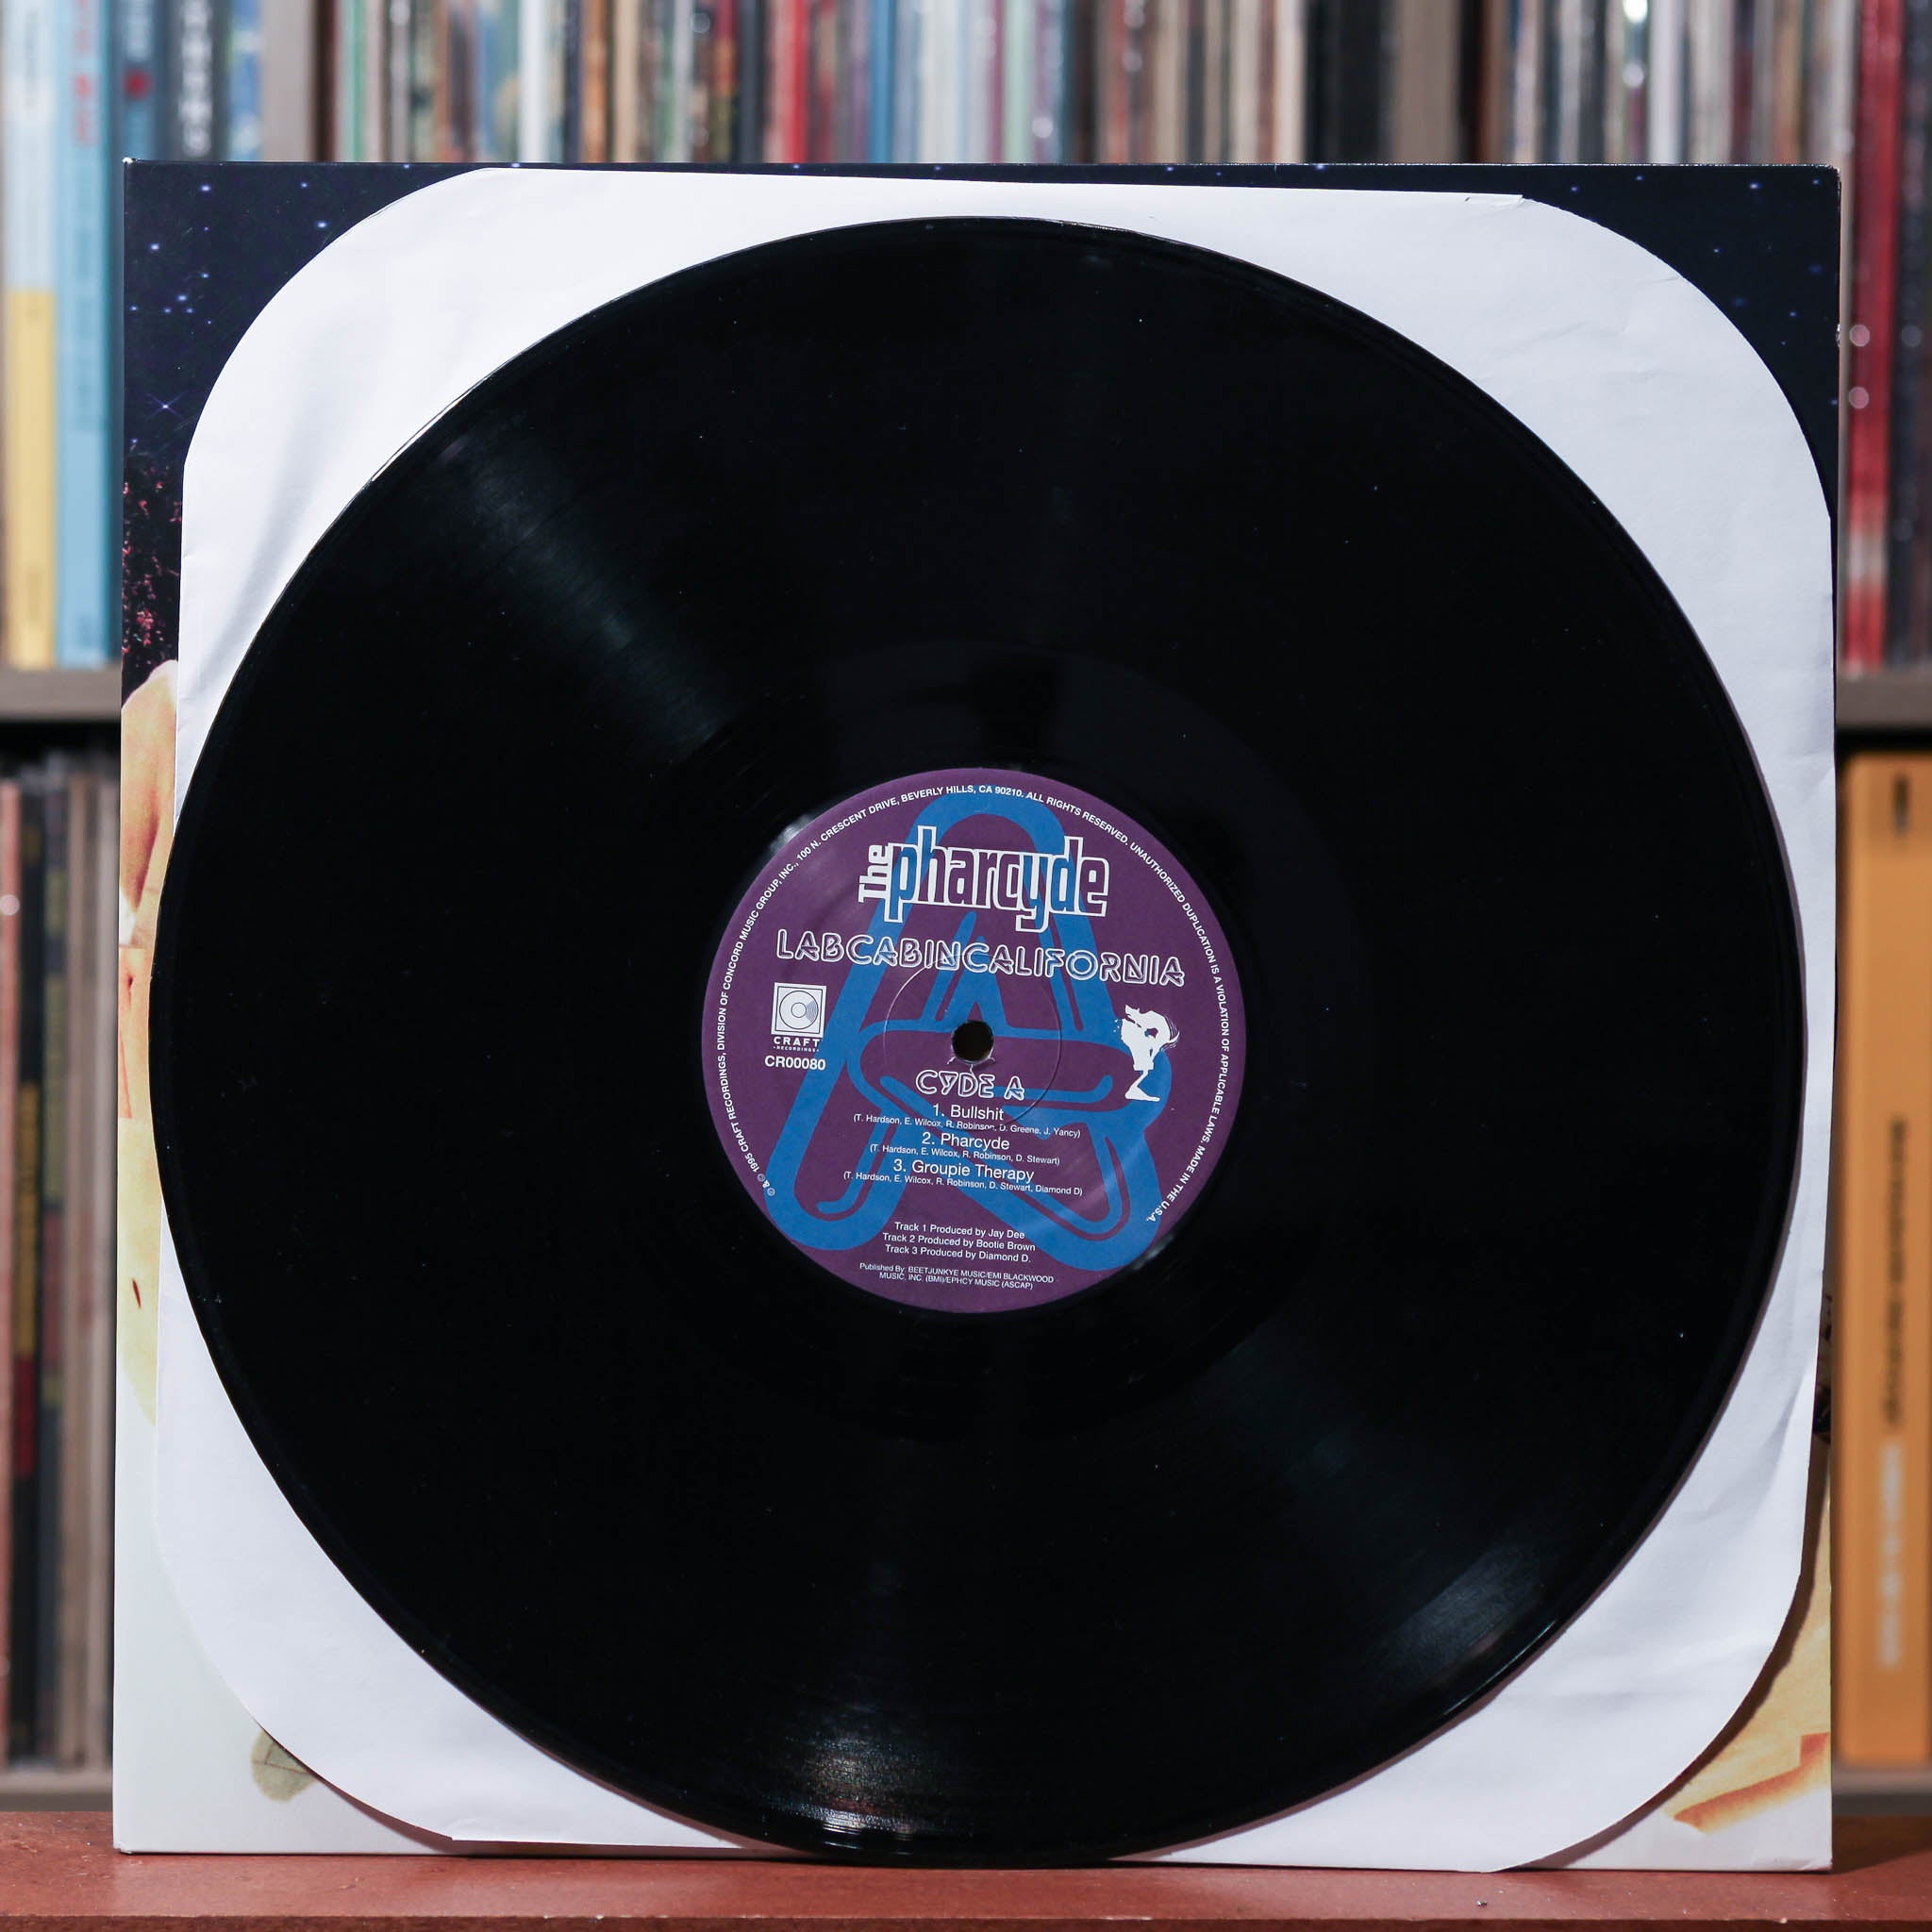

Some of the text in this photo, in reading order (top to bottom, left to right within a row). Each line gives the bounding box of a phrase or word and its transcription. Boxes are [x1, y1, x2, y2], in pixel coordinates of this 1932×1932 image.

[901, 788, 943, 803] BEVERLY
[945, 786, 976, 794] HILLS,
[994, 786, 1024, 797] 90210.
[1025, 791, 1045, 802] ALL
[867, 796, 899, 813] DRIVE,
[1045, 796, 1082, 816] RIGHTS
[820, 809, 867, 841] CRESCENT
[1081, 810, 1131, 845] RESERVED.
[795, 846, 811, 861] 100
[809, 838, 821, 849] N.
[858, 824, 1109, 933] The pharcyde
[1129, 841, 1185, 903] UNAUTHORIZED
[756, 877, 782, 910] GROUP,
[740, 909, 759, 941] MUSIC
[1181, 902, 1215, 963] DUPLICATION
[724, 941, 744, 990] CONCORD
[776, 928, 1185, 988] LABCABINCALIFORNIA
[1209, 964, 1219, 974] IS
[720, 991, 729, 1005] OF
[1215, 984, 1228, 1035] VIOLATION
[718, 1008, 726, 1050] DIVISION
[774, 1037, 820, 1047] CRAFT
[1221, 1038, 1228, 1051] OF
[765, 1056, 825, 1071] CR00080
[718, 1052, 736, 1120] RECORDINGS,
[916, 1070, 1024, 1101] CYDE A
[1211, 1054, 1227, 1113] APPLICABLE
[933, 1104, 1004, 1121] 1. Bullshit
[731, 1120, 749, 1153] CRAFT
[866, 1115, 902, 1124] Hardson,
[915, 1118, 942, 1127] Wilcox,
[957, 1121, 996, 1131] Robinson,
[1010, 1124, 1041, 1135] Greene,
[1054, 1127, 1081, 1139] Yancy)
[1200, 1115, 1216, 1144] LAWS.
[922, 1132, 1009, 1151] 2. Pharcyde
[744, 1152, 759, 1173] 1995
[870, 1144, 879, 1153] (T.
[883, 1145, 918, 1155] Hardson,
[931, 1148, 959, 1158] Wilcox,
[974, 1152, 1013, 1161] Robinson,
[1027, 1156, 1059, 1166] Stewart)
[1185, 1144, 1205, 1173] MADE
[893, 1159, 1034, 1183] 3. Groupie Therapy
[1178, 1172, 1190, 1183] IN
[856, 1173, 891, 1182] Hardson,
[905, 1175, 933, 1185] Wilcox,
[947, 1178, 987, 1189] Robinson,
[1000, 1182, 1033, 1192] Stewart,
[1036, 1185, 1071, 1194] Diamond
[1074, 1188, 1082, 1196] D)
[1166, 1182, 1182, 1201] THE
[1145, 1199, 1169, 1224] U.S.A.
[894, 1222, 919, 1232] Track
[930, 1224, 973, 1235] Produced
[975, 1227, 986, 1238] by
[988, 1228, 1004, 1239] Jay
[1007, 1230, 1024, 1240] Dee
[883, 1233, 907, 1242] Track
[918, 1236, 960, 1246] Produced
[963, 1238, 974, 1249] by
[1007, 1241, 1035, 1251] Brown
[885, 1244, 909, 1254] Track
[920, 1247, 962, 1257] Produced
[965, 1249, 975, 1260] by
[978, 1250, 1018, 1262] Diamond
[1021, 1255, 1031, 1263] D.
[859, 1263, 893, 1272] Published
[908, 1266, 958, 1276] BEETJUNKYE
[1004, 1274, 1054, 1283] BLACKWOOD
[1002, 1281, 1033, 1291] (ASCAP)
